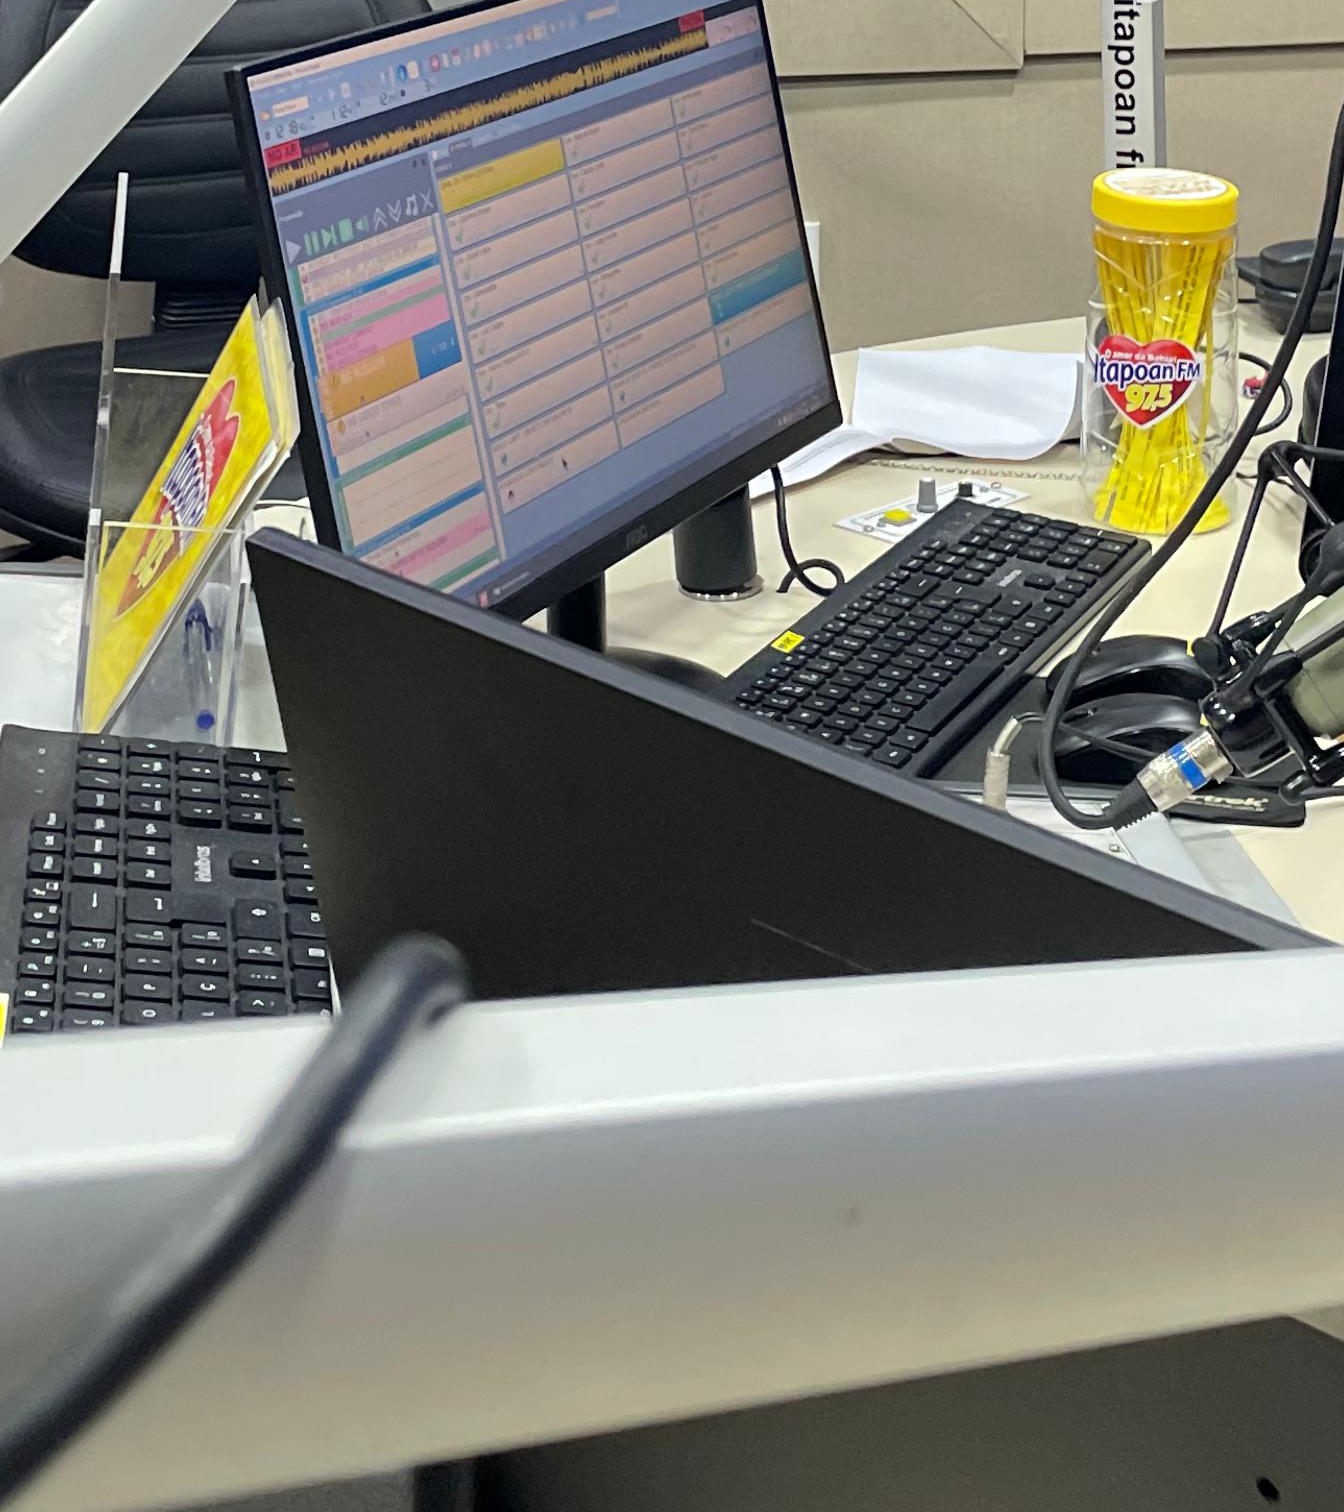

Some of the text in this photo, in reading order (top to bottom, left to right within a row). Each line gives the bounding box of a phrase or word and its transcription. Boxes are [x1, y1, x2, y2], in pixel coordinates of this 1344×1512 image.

[1115, 149, 1145, 169] f
[1093, 353, 1201, 389] Itapoan FM
